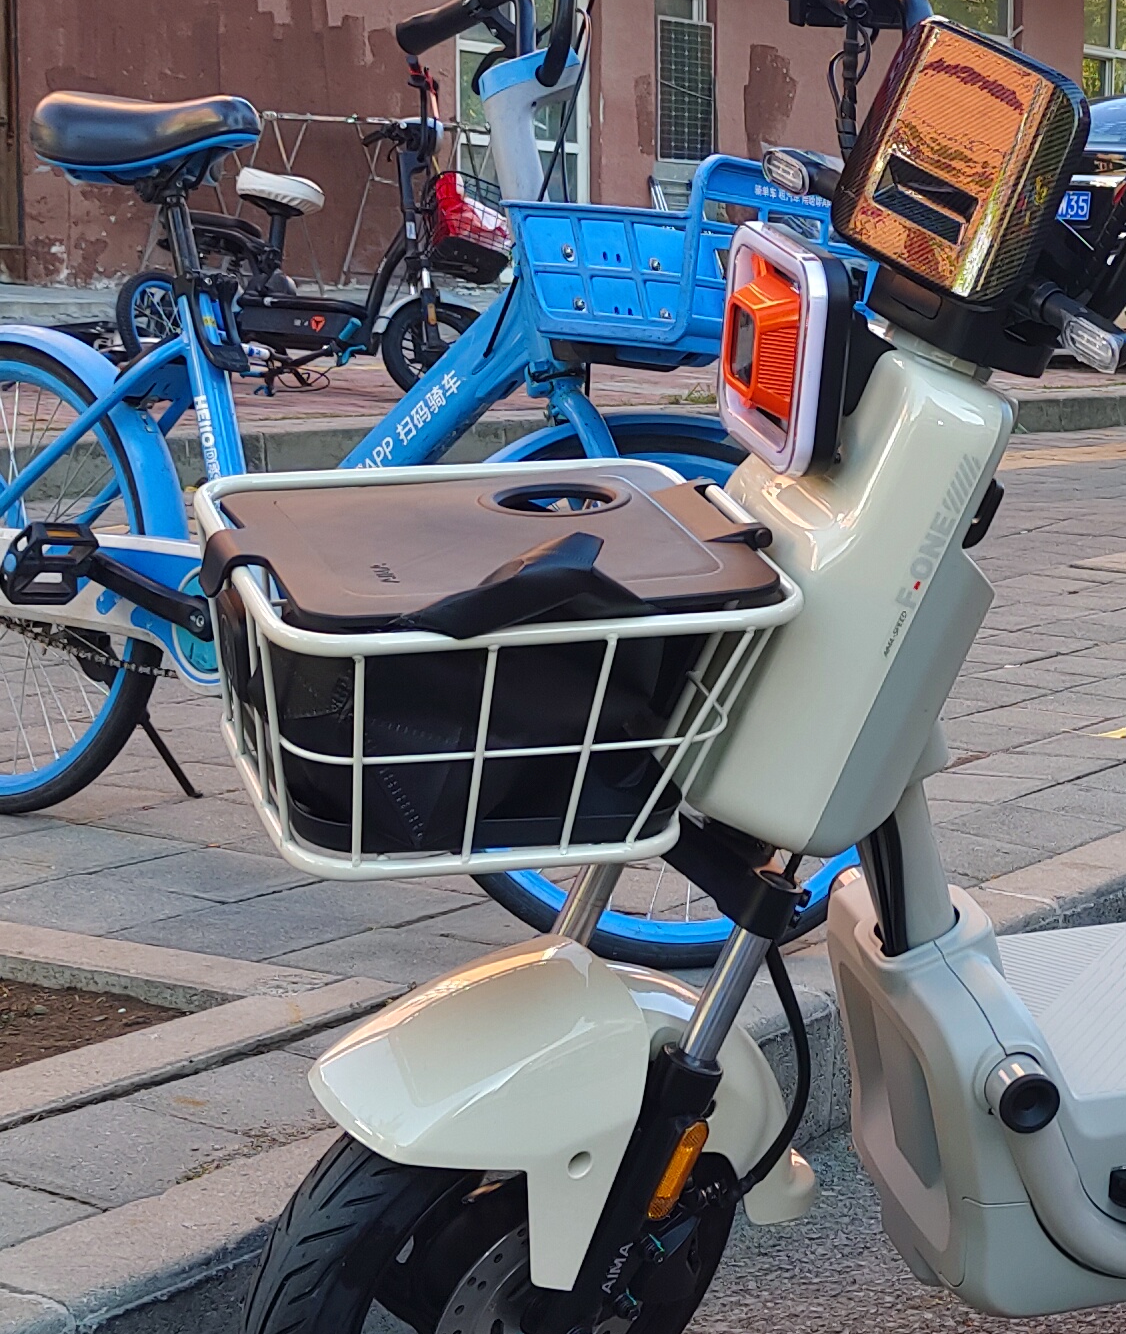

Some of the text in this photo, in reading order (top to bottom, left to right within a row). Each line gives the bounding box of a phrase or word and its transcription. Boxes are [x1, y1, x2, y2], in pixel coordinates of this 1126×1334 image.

[356, 369, 462, 469] APP 扫码骑车
[602, 1242, 634, 1294] AIMA
